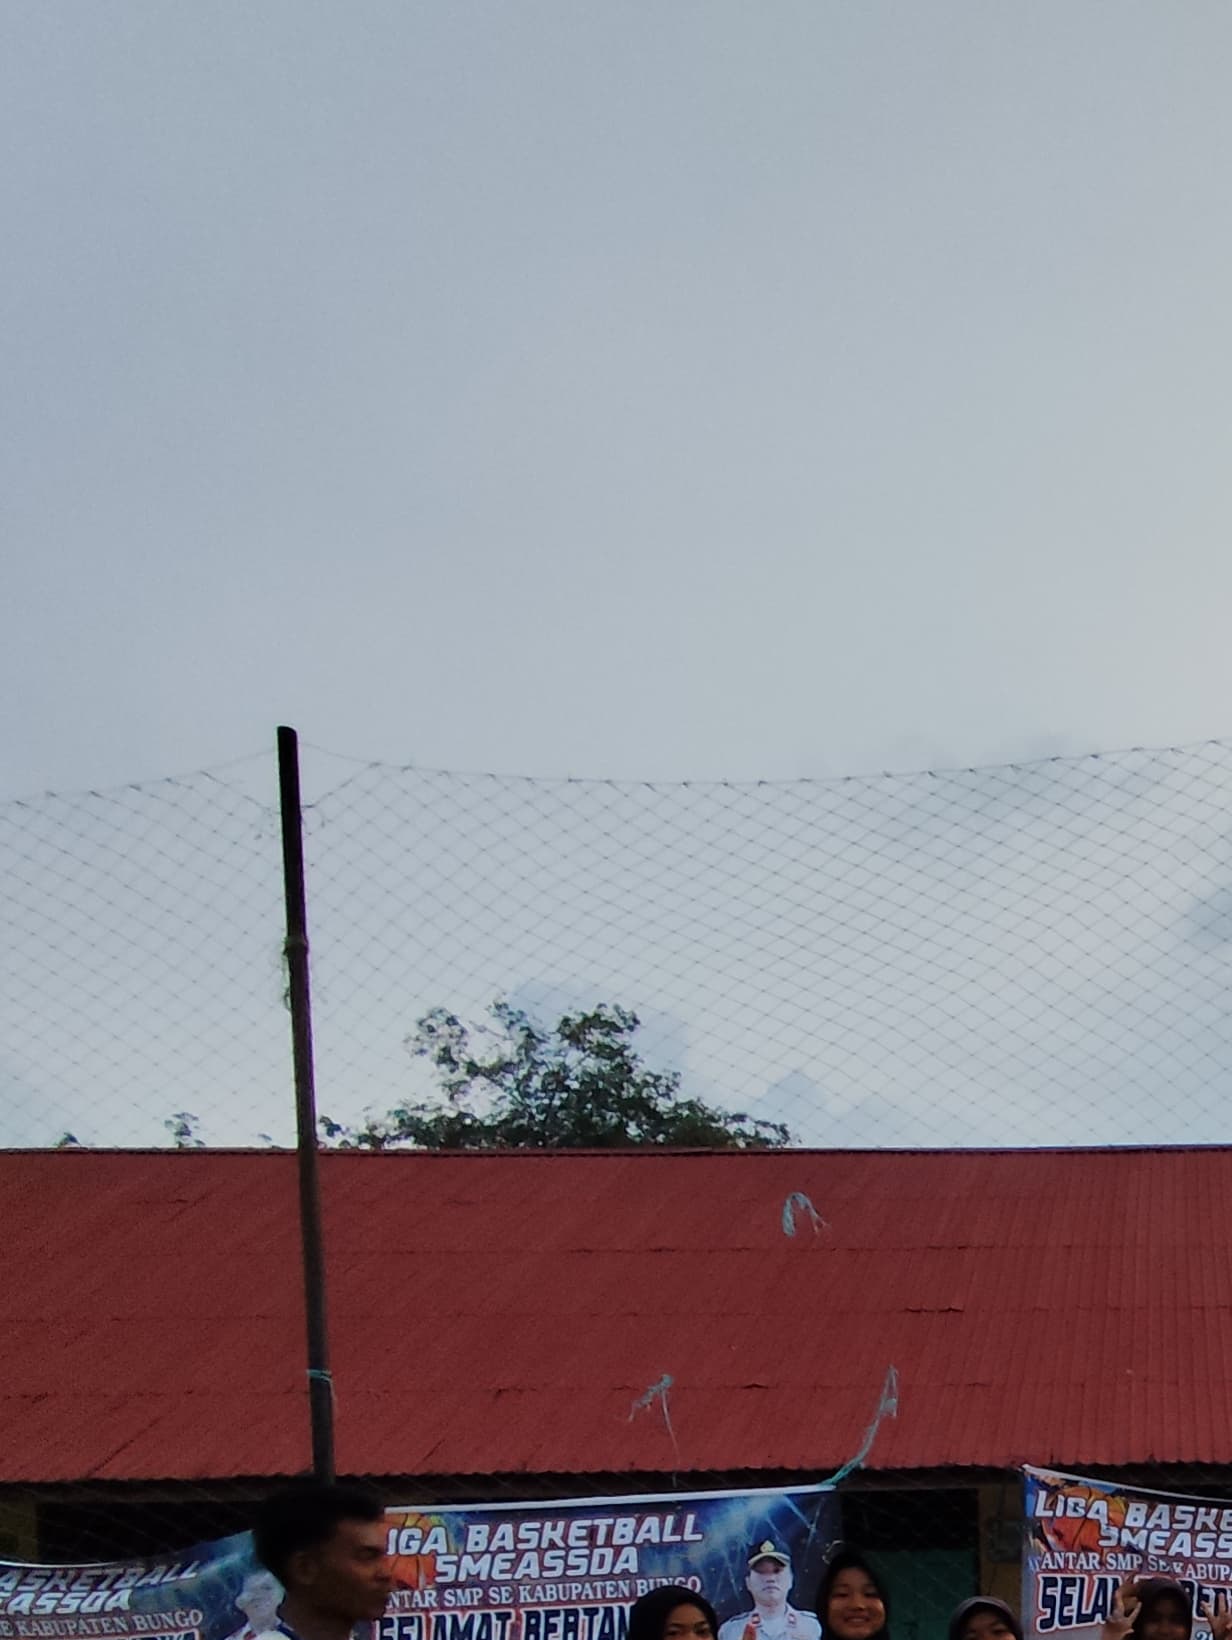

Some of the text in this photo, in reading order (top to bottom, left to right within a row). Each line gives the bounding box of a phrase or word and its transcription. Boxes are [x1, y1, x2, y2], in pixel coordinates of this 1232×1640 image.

[1035, 1490, 1109, 1522] LIGA
[466, 1514, 703, 1552] BASKETBALL
[435, 1546, 639, 1583] SMEASSDA
[1041, 1551, 1101, 1570] ANTAR
[1105, 1552, 1143, 1571] SMP
[444, 1587, 483, 1607] SMP
[488, 1586, 514, 1605] SE
[519, 1579, 631, 1604] KABUPATEN
[16, 1616, 129, 1637] KABUPATEN
[133, 1609, 203, 1633] BUNGO
